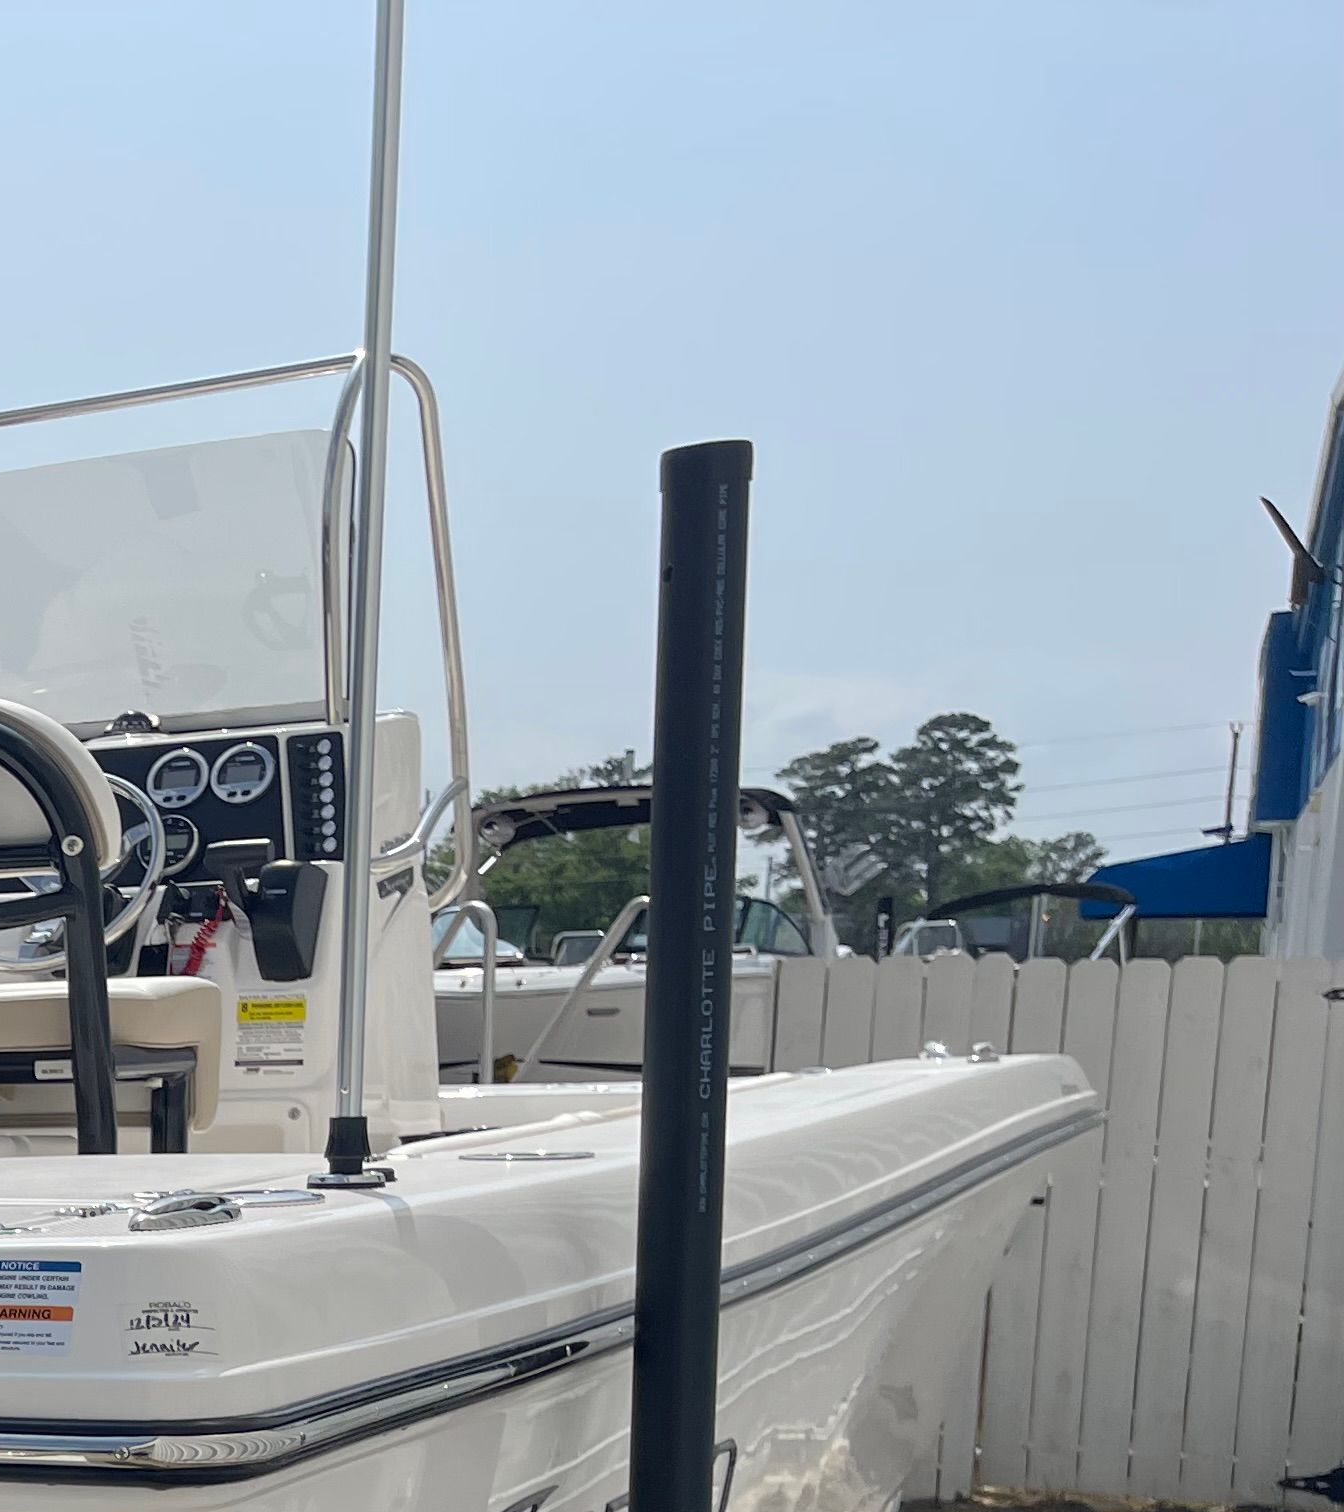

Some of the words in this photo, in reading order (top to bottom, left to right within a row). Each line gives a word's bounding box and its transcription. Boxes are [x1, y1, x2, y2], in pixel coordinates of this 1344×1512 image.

[703, 864, 717, 932] PIPE
[699, 949, 716, 1099] CHARLOTTE
[0, 1261, 41, 1271] NOTICE
